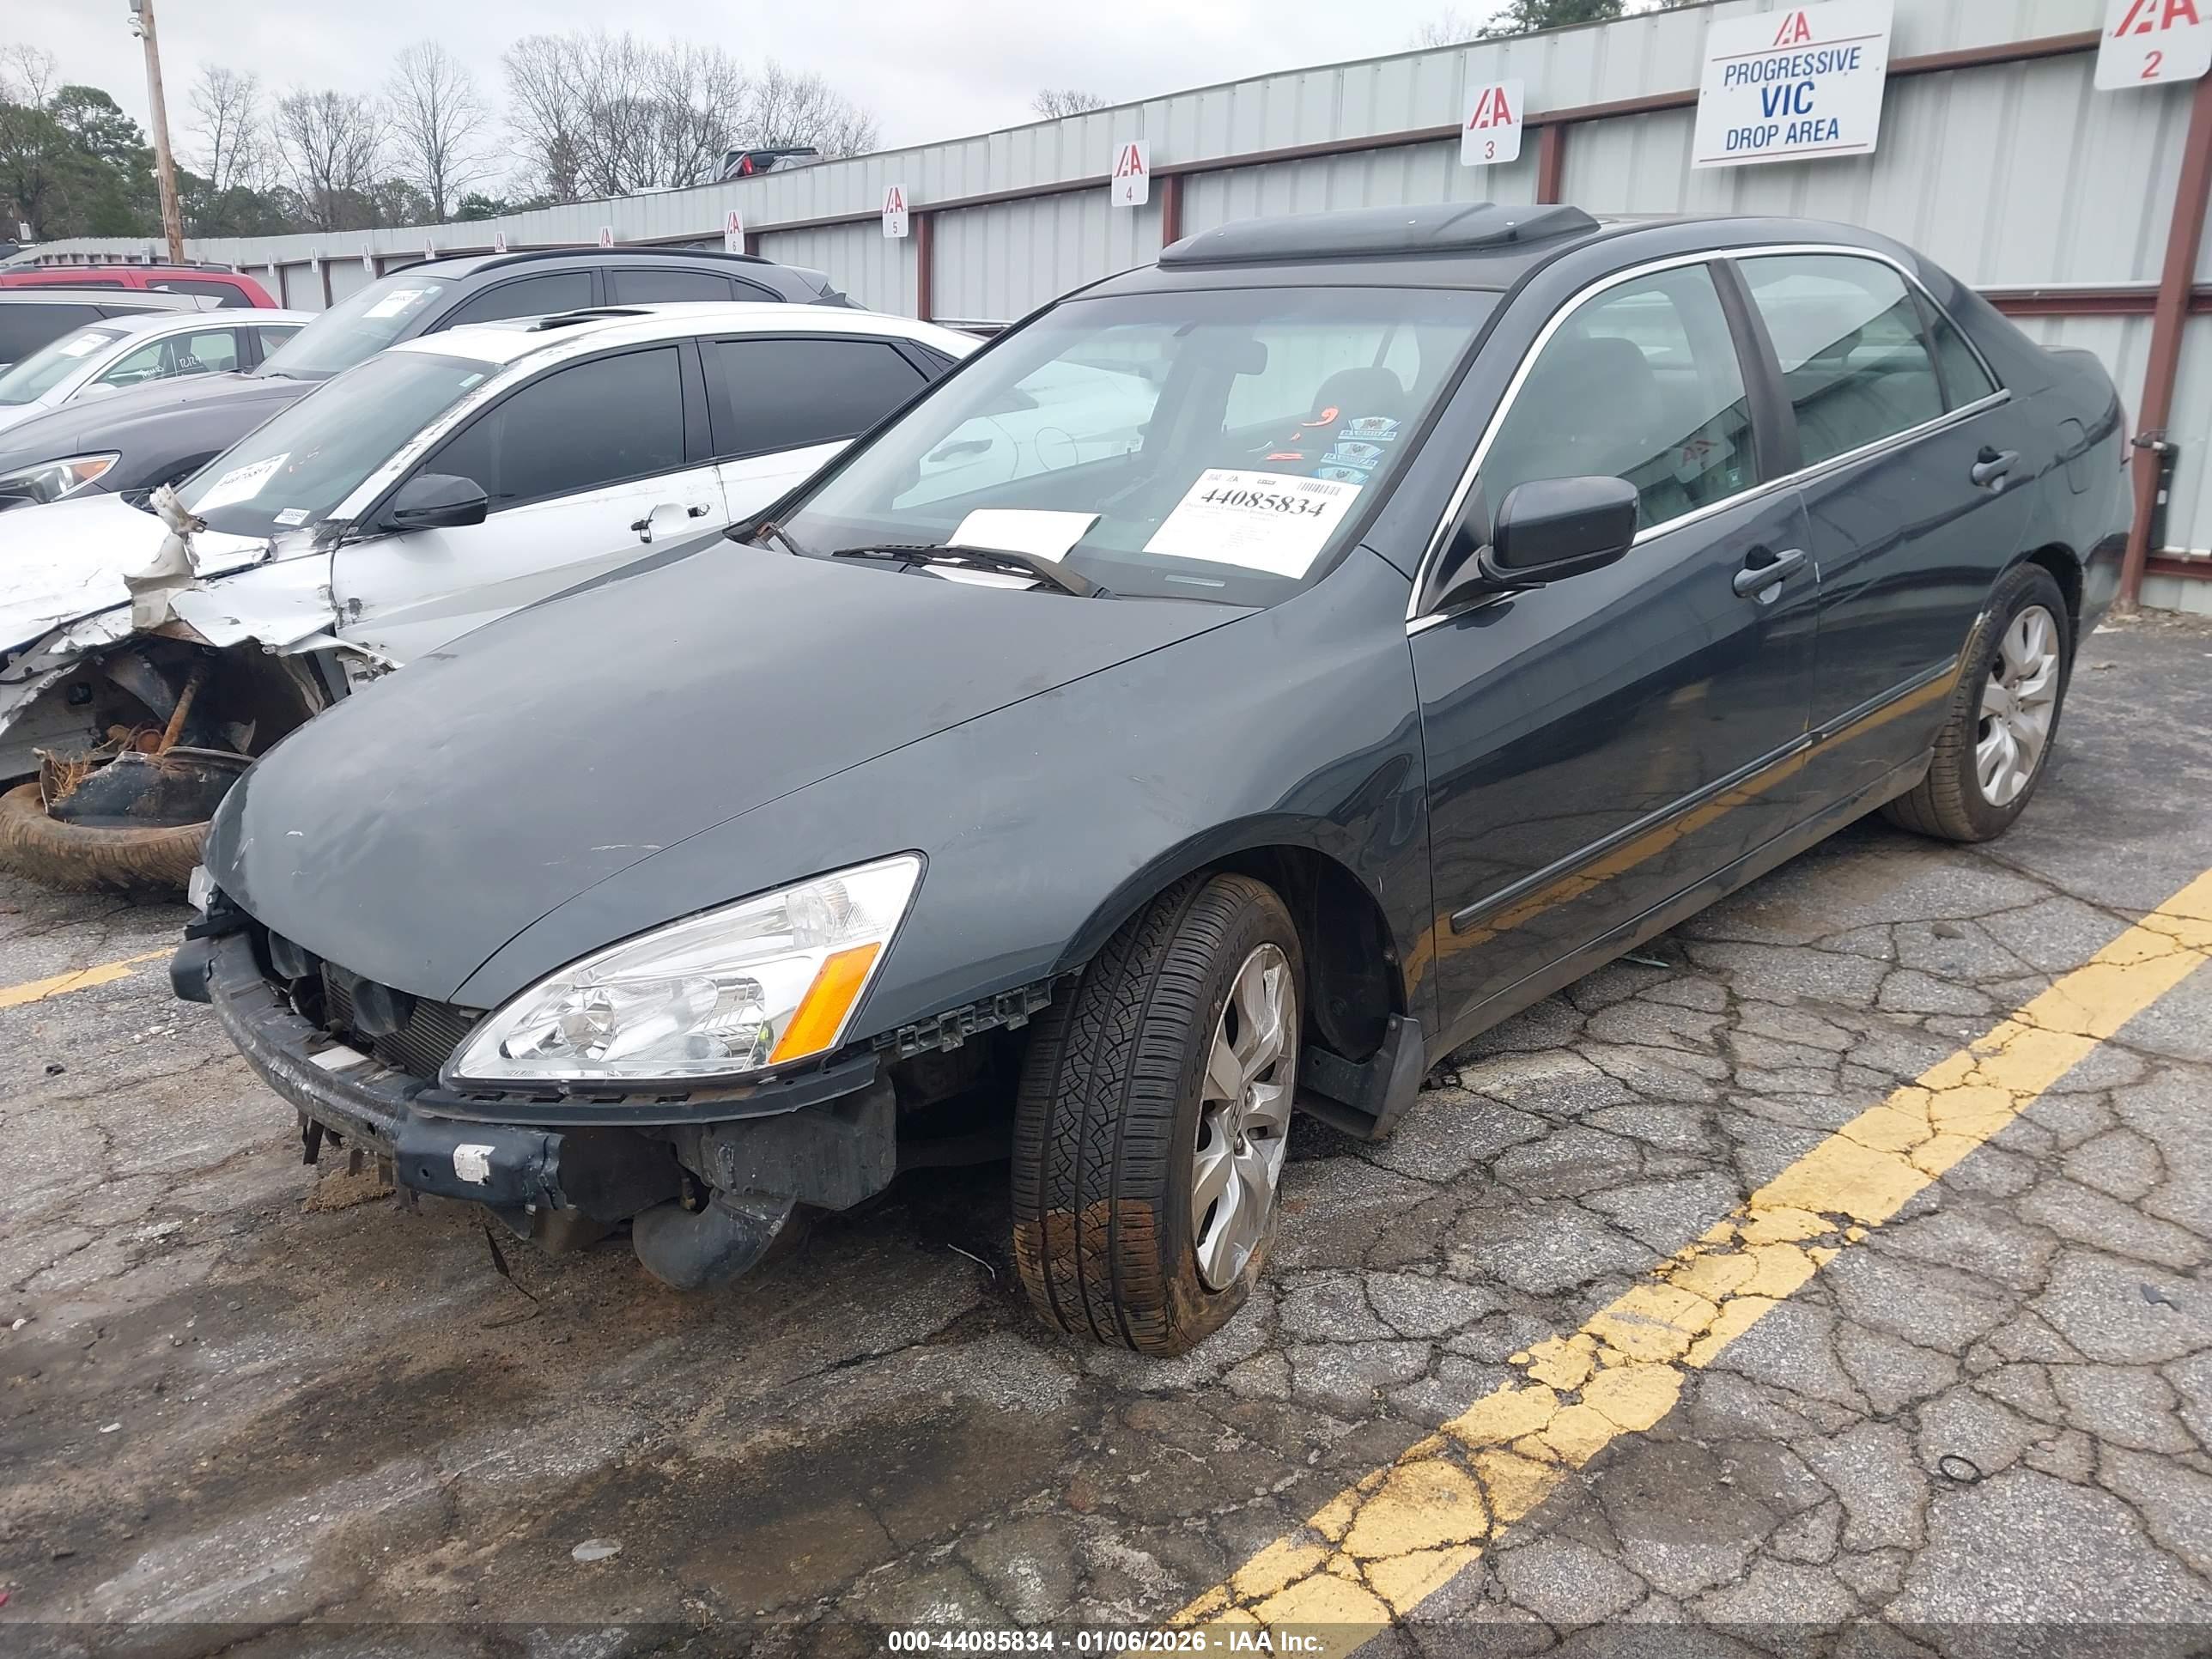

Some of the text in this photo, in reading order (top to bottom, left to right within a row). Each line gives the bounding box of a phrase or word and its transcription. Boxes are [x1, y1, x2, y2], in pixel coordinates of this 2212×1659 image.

[1724, 46, 1862, 87] PROGRESSIVE
[2141, 50, 2163, 79] 2
[1761, 81, 1815, 118] VIC
[1726, 117, 1840, 151] DROP AREA
[1485, 140, 1495, 160] 3
[1126, 185, 1133, 202] 4
[892, 221, 898, 234] 5
[1200, 488, 1328, 518] 44085834
